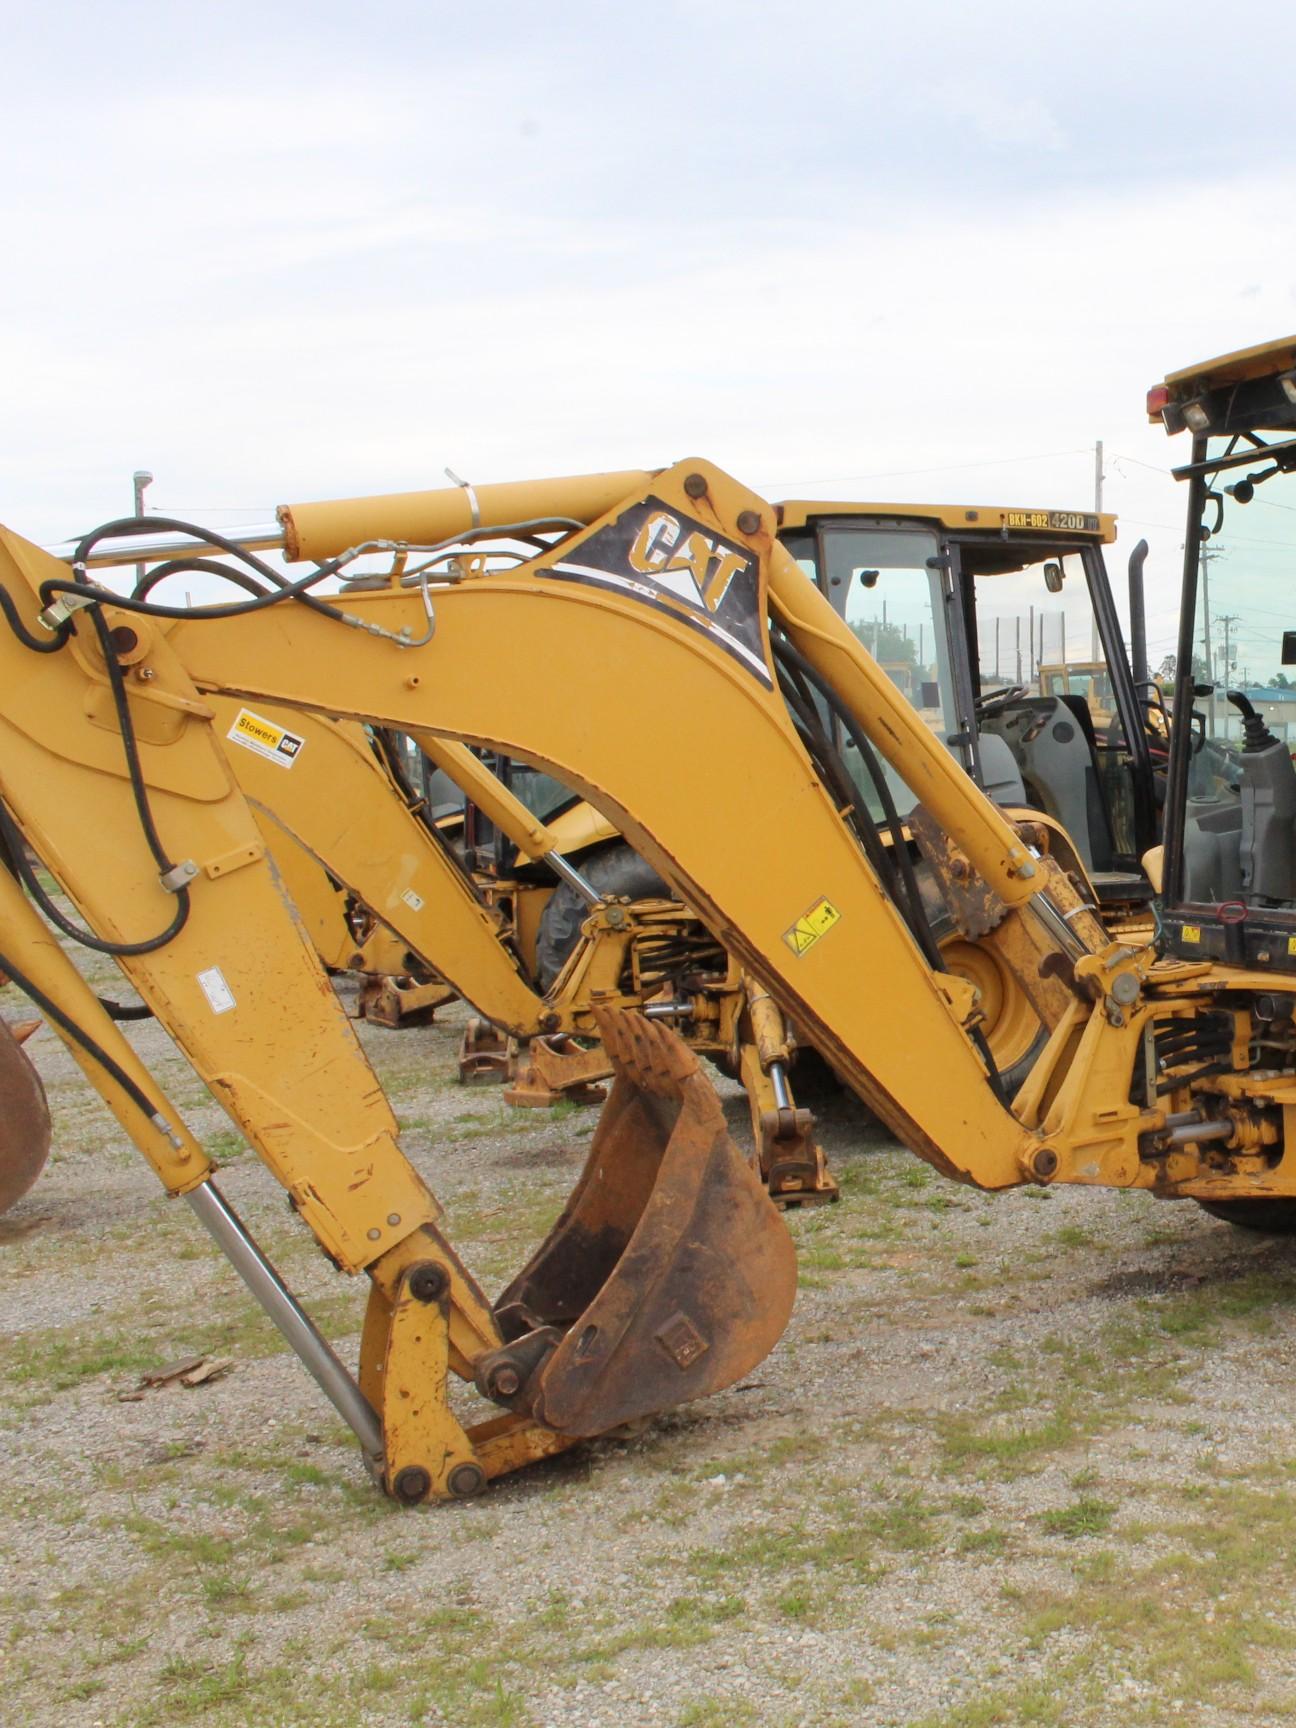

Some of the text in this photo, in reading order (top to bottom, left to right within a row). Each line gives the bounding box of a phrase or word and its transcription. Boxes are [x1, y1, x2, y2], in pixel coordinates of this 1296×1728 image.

[1009, 513, 1048, 528] BKH-602
[1052, 513, 1084, 529] 420D
[628, 511, 749, 613] CAT
[239, 718, 277, 744] Stowers
[281, 738, 299, 753] CAT
